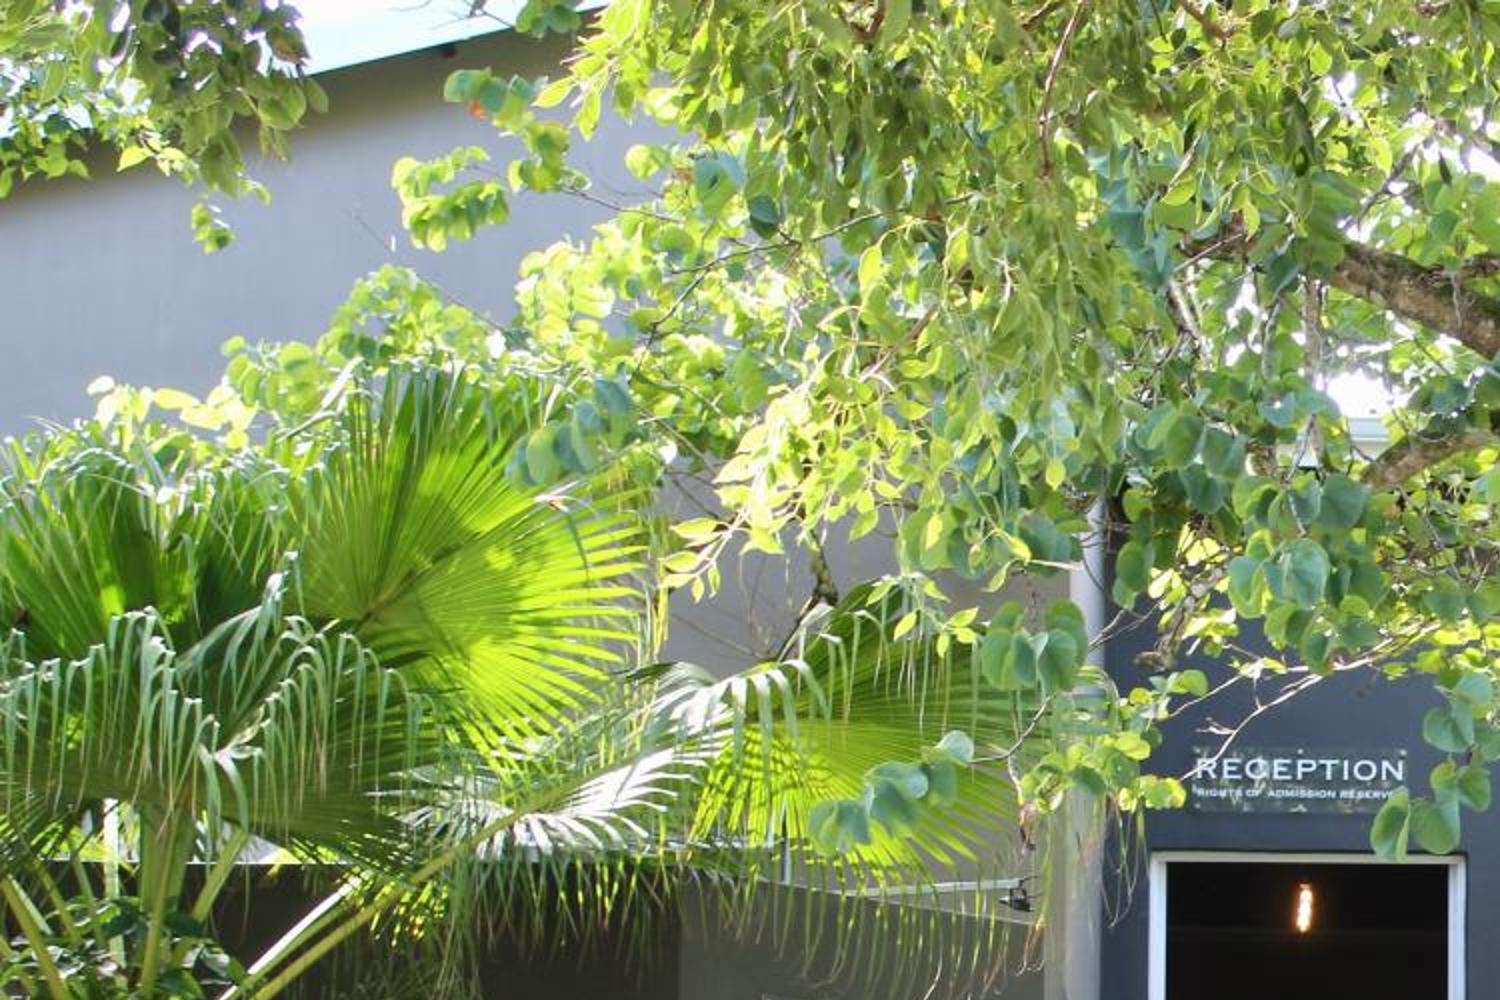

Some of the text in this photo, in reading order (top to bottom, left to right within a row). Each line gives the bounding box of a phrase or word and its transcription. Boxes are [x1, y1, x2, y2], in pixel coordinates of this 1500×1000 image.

[1197, 757, 1404, 781] RECEPTION
[1196, 788, 1393, 800] RIGHTS OF ADMISSION RESERV
